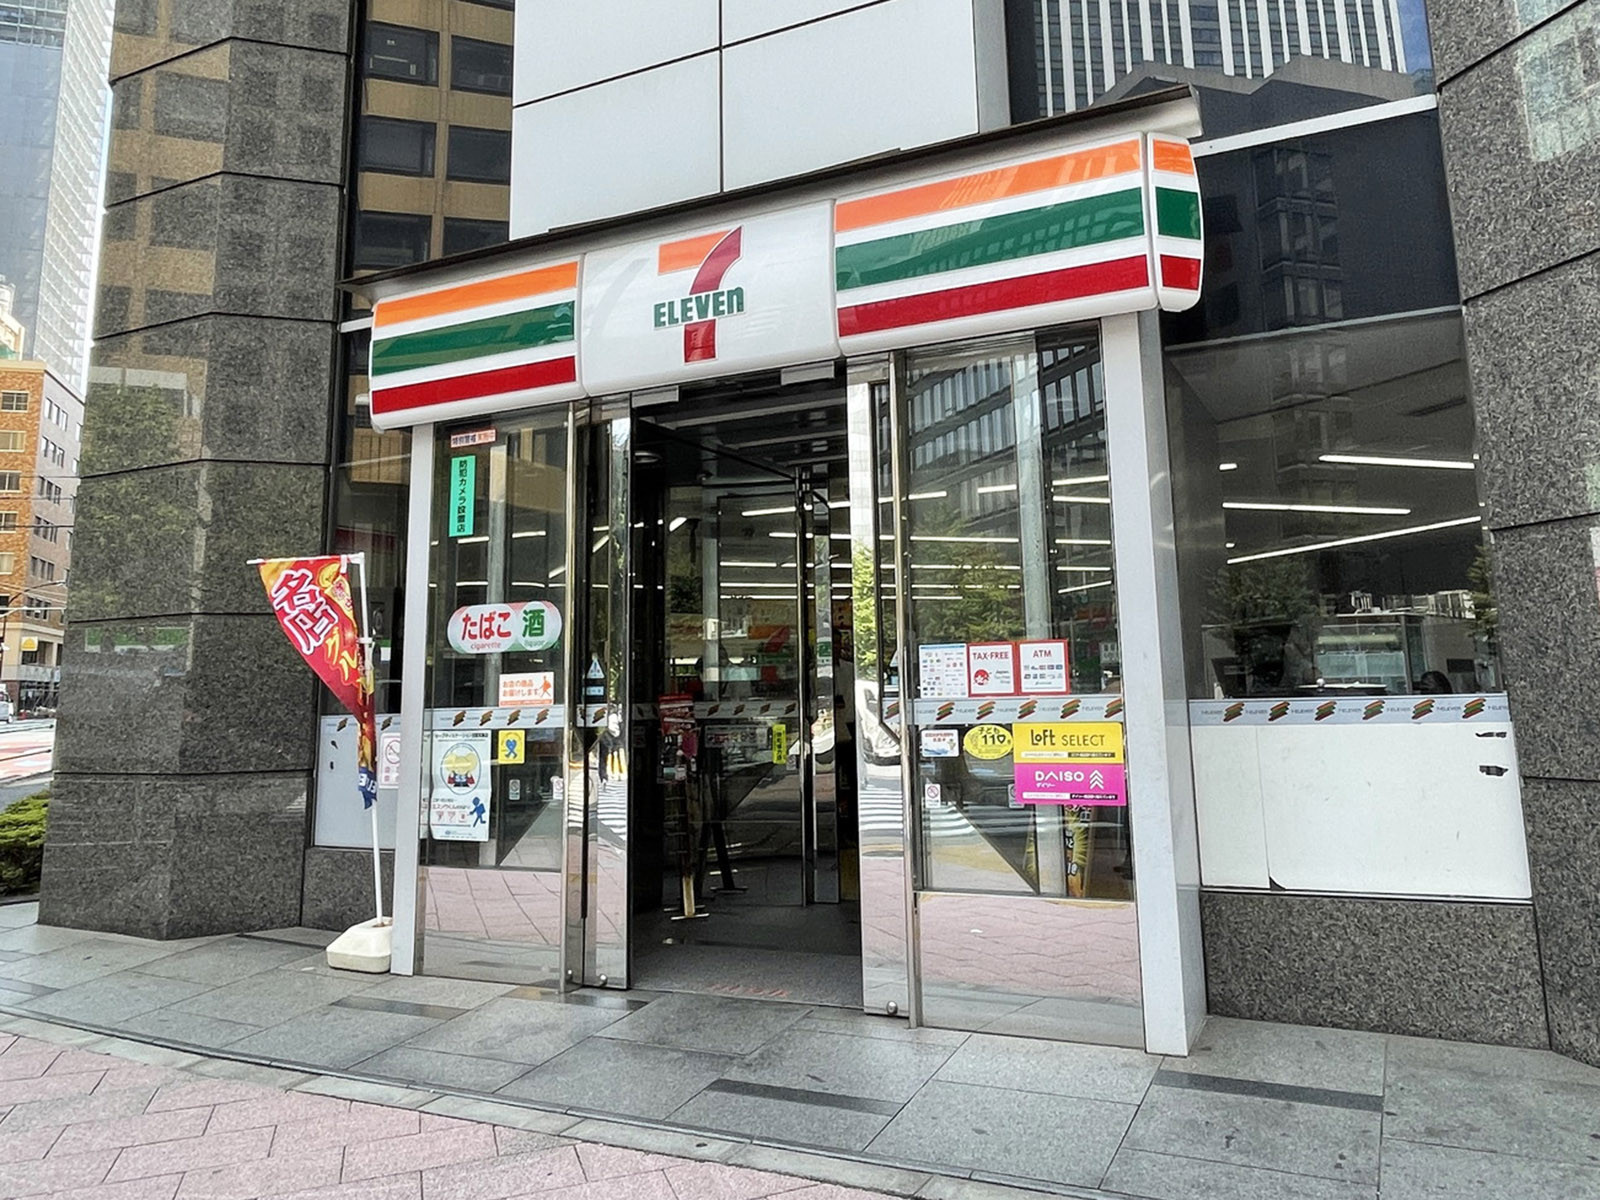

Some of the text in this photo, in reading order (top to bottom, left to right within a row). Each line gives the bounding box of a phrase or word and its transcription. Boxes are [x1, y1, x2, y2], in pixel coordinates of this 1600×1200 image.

[658, 226, 742, 363] 7
[457, 459, 468, 533] 防犯カメラ設置店
[462, 609, 545, 641] たばこ 酒
[471, 642, 501, 651] cigarette
[973, 651, 1009, 660] TAX-FREE
[1033, 649, 1052, 658] ATM
[978, 727, 1000, 735] 子ども
[1062, 734, 1105, 746] SELECT
